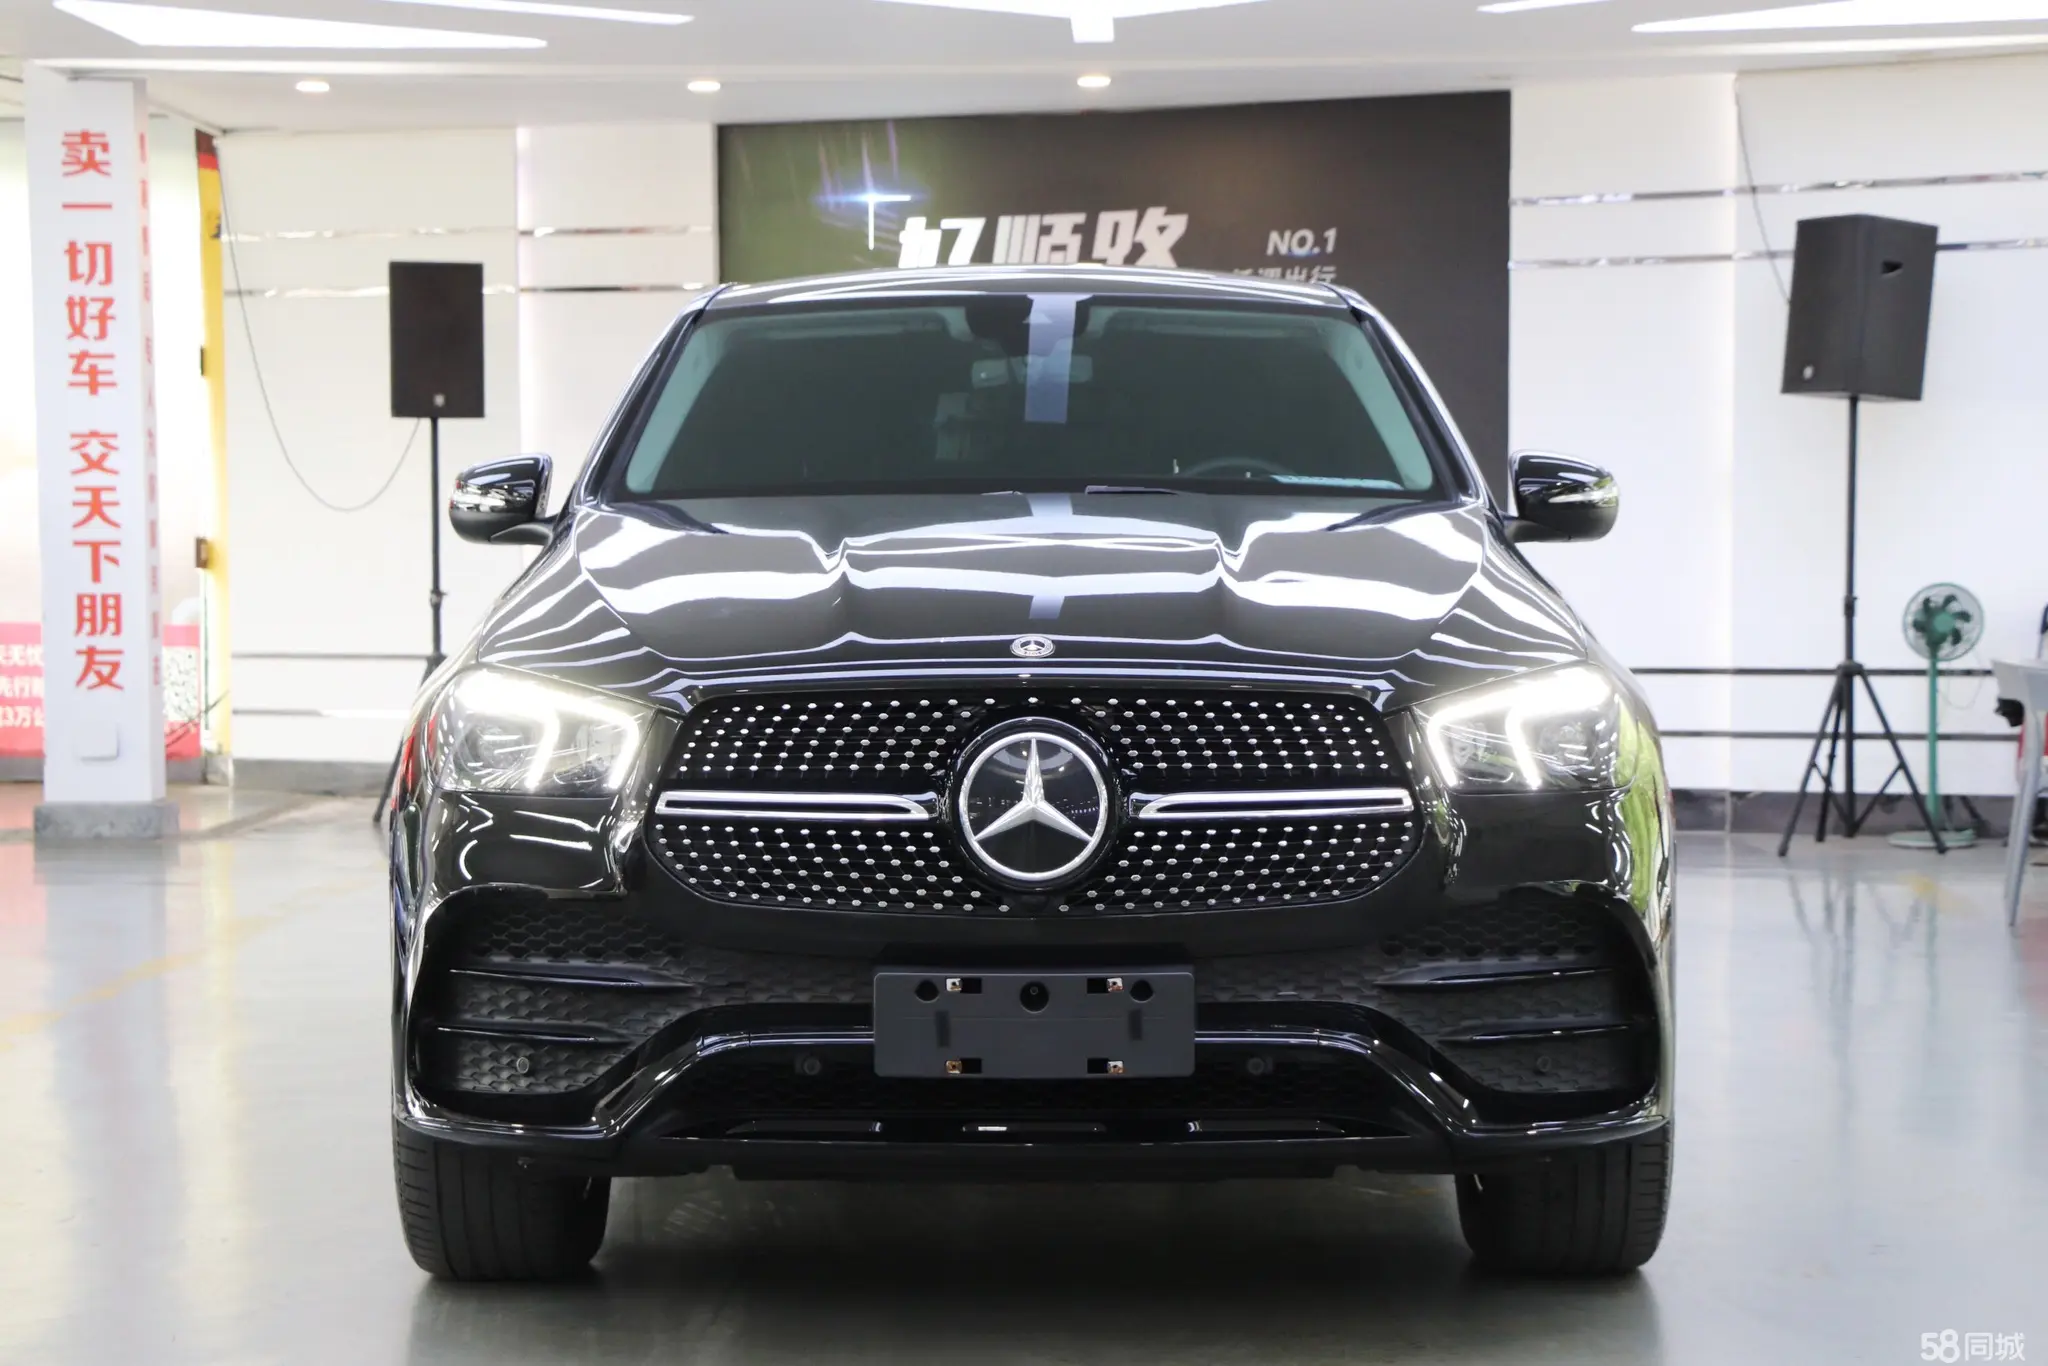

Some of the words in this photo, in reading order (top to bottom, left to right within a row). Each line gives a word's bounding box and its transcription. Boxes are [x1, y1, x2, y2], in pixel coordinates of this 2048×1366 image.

[61, 129, 117, 396] 卖一切好车
[1266, 227, 1338, 256] NO.1
[69, 430, 125, 691] 交天下朋友
